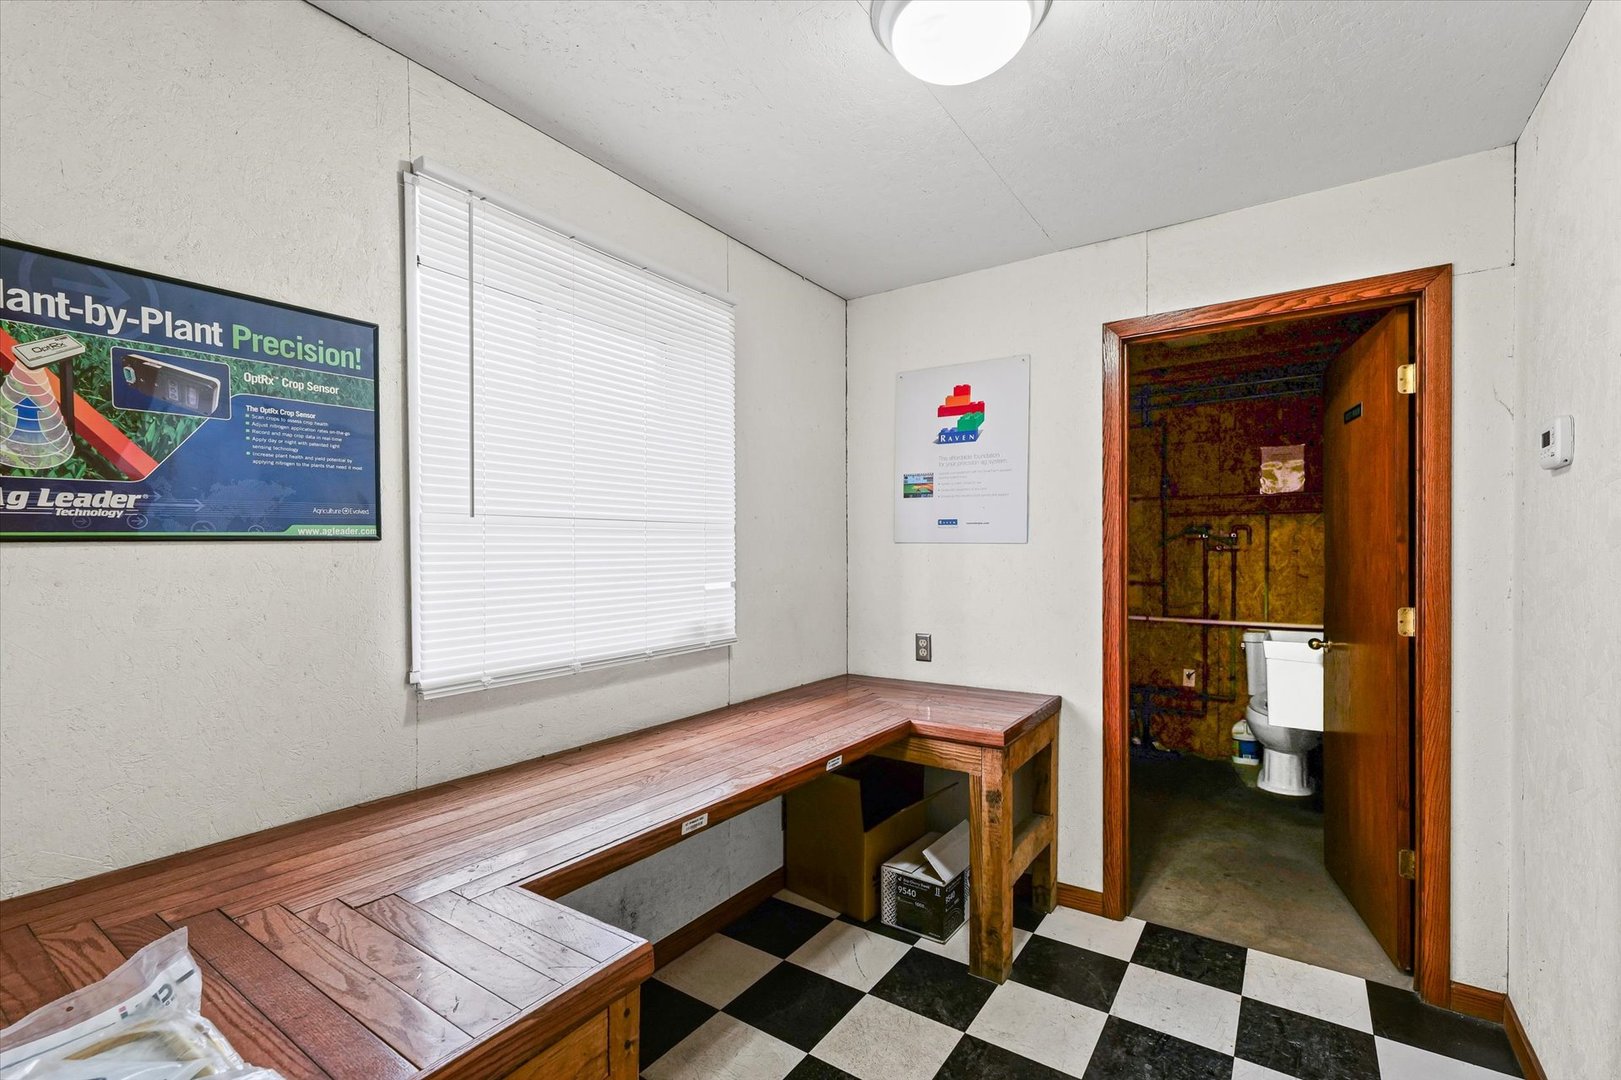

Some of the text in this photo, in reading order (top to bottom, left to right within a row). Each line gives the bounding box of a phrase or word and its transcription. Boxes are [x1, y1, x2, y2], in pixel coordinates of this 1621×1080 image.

[0, 278, 361, 370] lant-by-Plant Precision!
[32, 342, 67, 353] OptRx
[282, 378, 304, 392] Crop
[306, 381, 340, 394] Sensor
[260, 406, 279, 415] OptRx
[280, 408, 294, 417] Crop
[295, 410, 316, 419] Sensor
[940, 434, 975, 443] RAVEN
[55, 508, 124, 518] Technology
[298, 528, 377, 536] www.agleader.com
[898, 886, 916, 897] 9540
